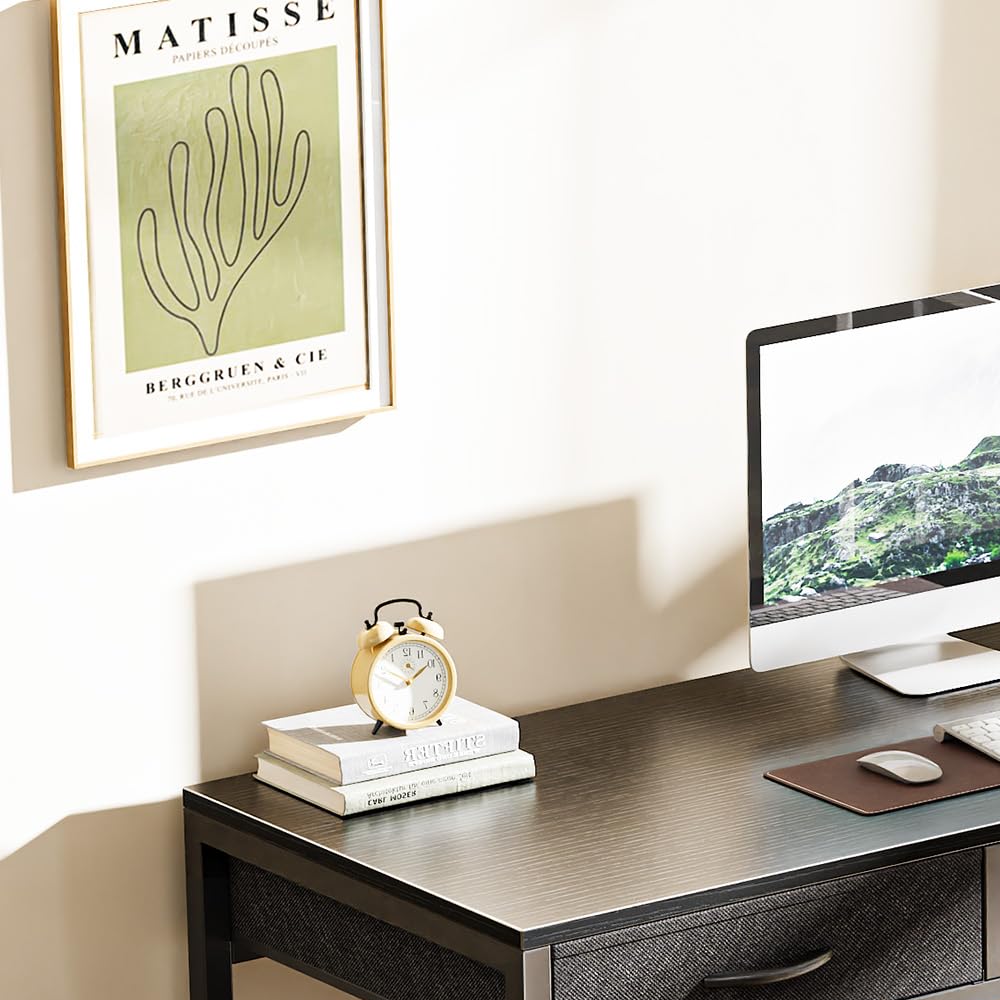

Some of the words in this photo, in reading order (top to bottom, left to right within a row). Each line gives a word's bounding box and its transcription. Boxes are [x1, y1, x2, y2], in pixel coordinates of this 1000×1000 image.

[113, 0, 335, 58] MATISSE
[172, 48, 217, 64] PAPIERS
[146, 361, 264, 394] BERGGRUEN
[274, 356, 286, 370] &
[295, 348, 328, 365] CIE
